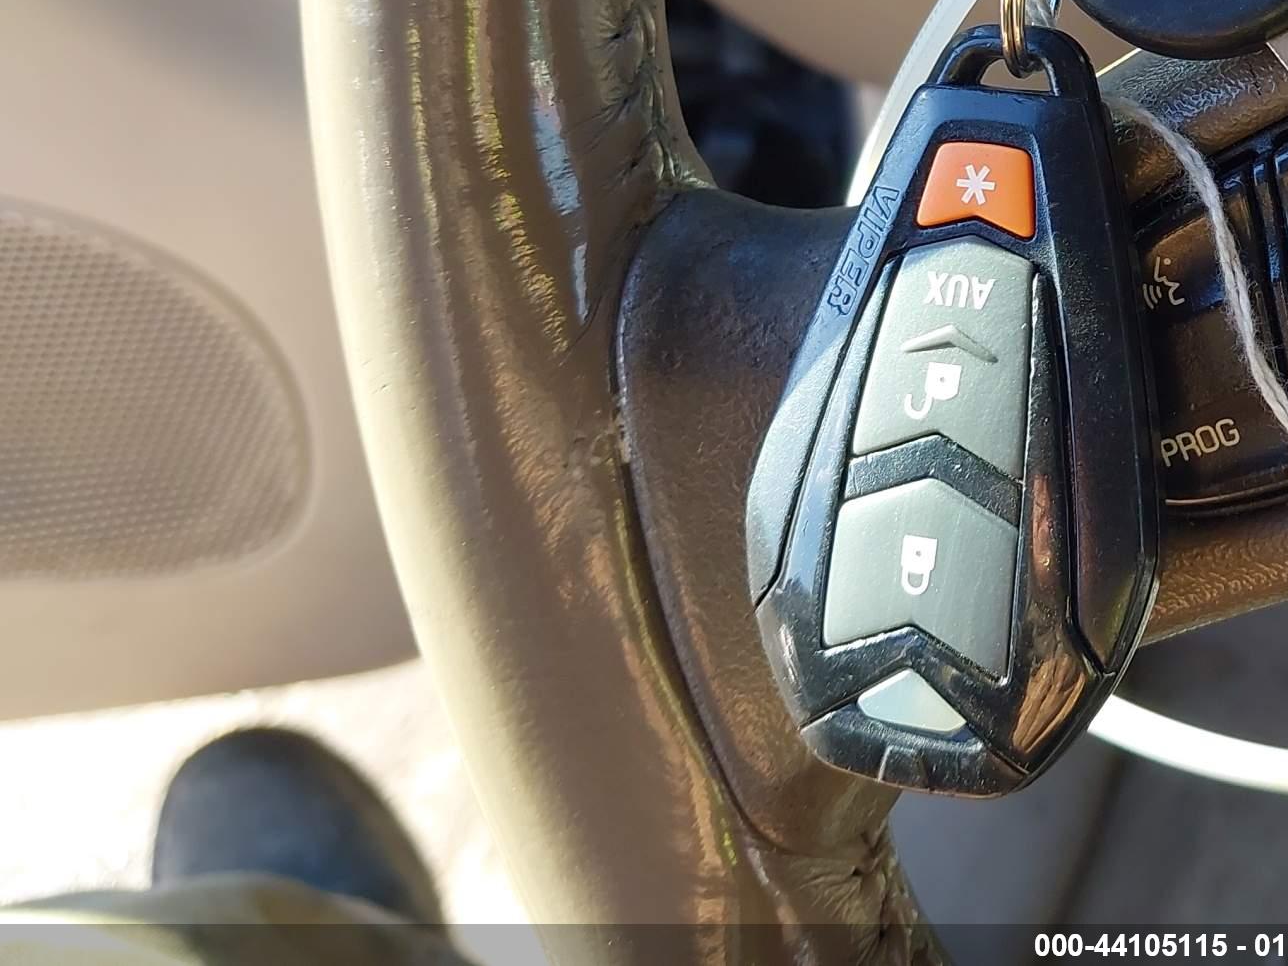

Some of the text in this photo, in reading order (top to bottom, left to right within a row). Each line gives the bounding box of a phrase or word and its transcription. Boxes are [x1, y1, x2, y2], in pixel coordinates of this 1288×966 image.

[826, 185, 901, 316] VIPER
[923, 270, 998, 311] AUX
[1159, 418, 1241, 468] PROG
